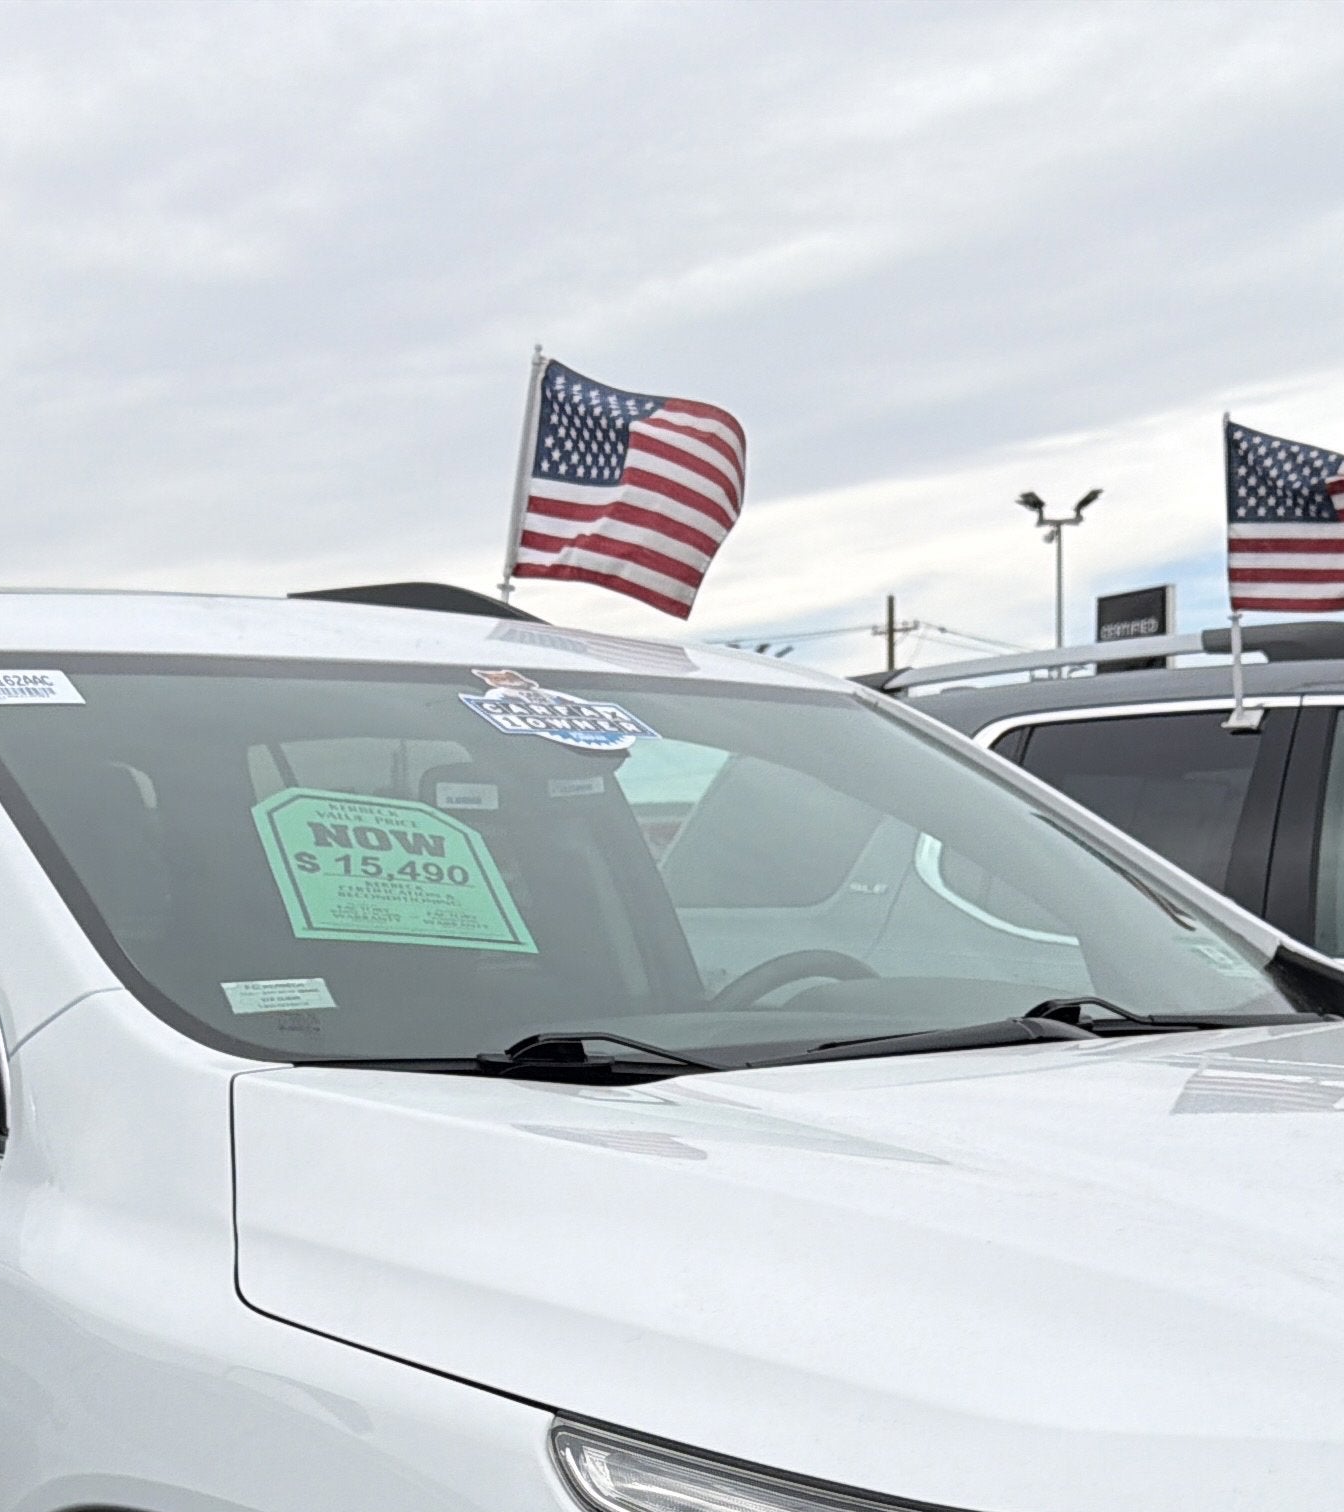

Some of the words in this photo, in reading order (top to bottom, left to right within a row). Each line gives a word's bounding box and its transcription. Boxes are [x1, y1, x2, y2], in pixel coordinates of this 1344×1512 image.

[482, 702, 633, 721] CARFAX
[526, 717, 643, 733] OWNER
[315, 809, 364, 823] VALUE
[375, 816, 420, 829] PRICE
[329, 803, 400, 818] KERBECK
[307, 821, 446, 858] NOW
[293, 851, 322, 874] $
[334, 853, 470, 886] 15,490
